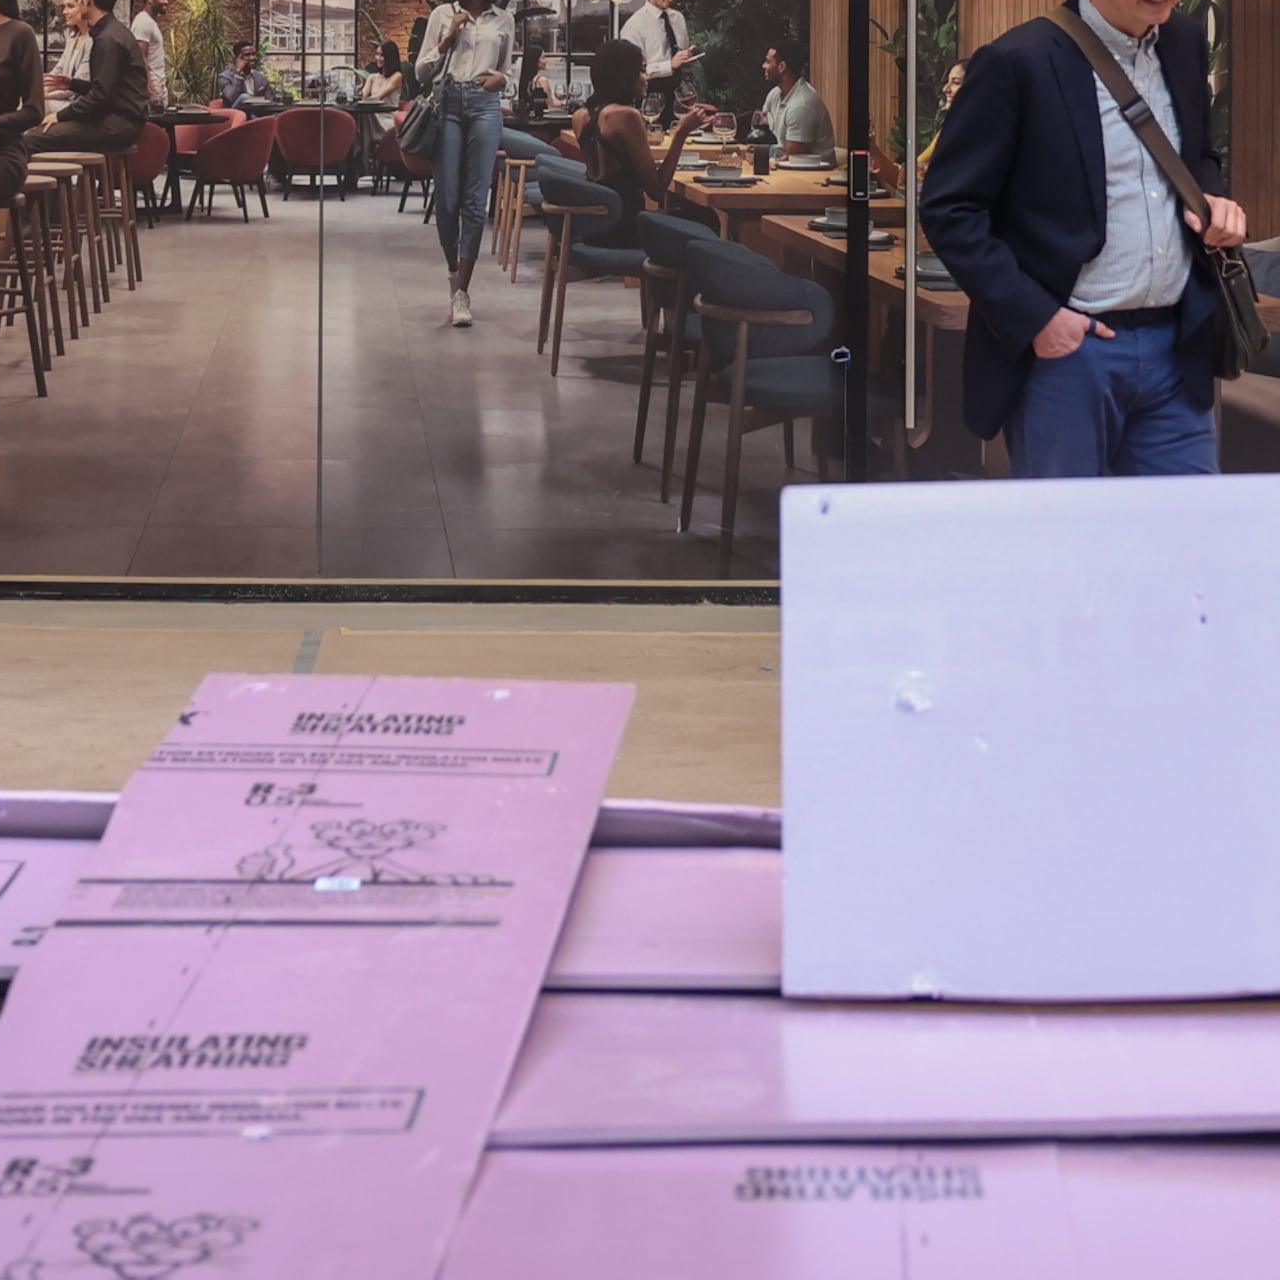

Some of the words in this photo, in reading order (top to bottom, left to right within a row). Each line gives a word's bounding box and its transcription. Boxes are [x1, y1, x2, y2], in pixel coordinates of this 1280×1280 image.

[294, 711, 466, 727] INSULATING
[289, 721, 457, 736] SHEATHING
[83, 1033, 310, 1054] INSULATING
[73, 1050, 291, 1073] SHEATHING
